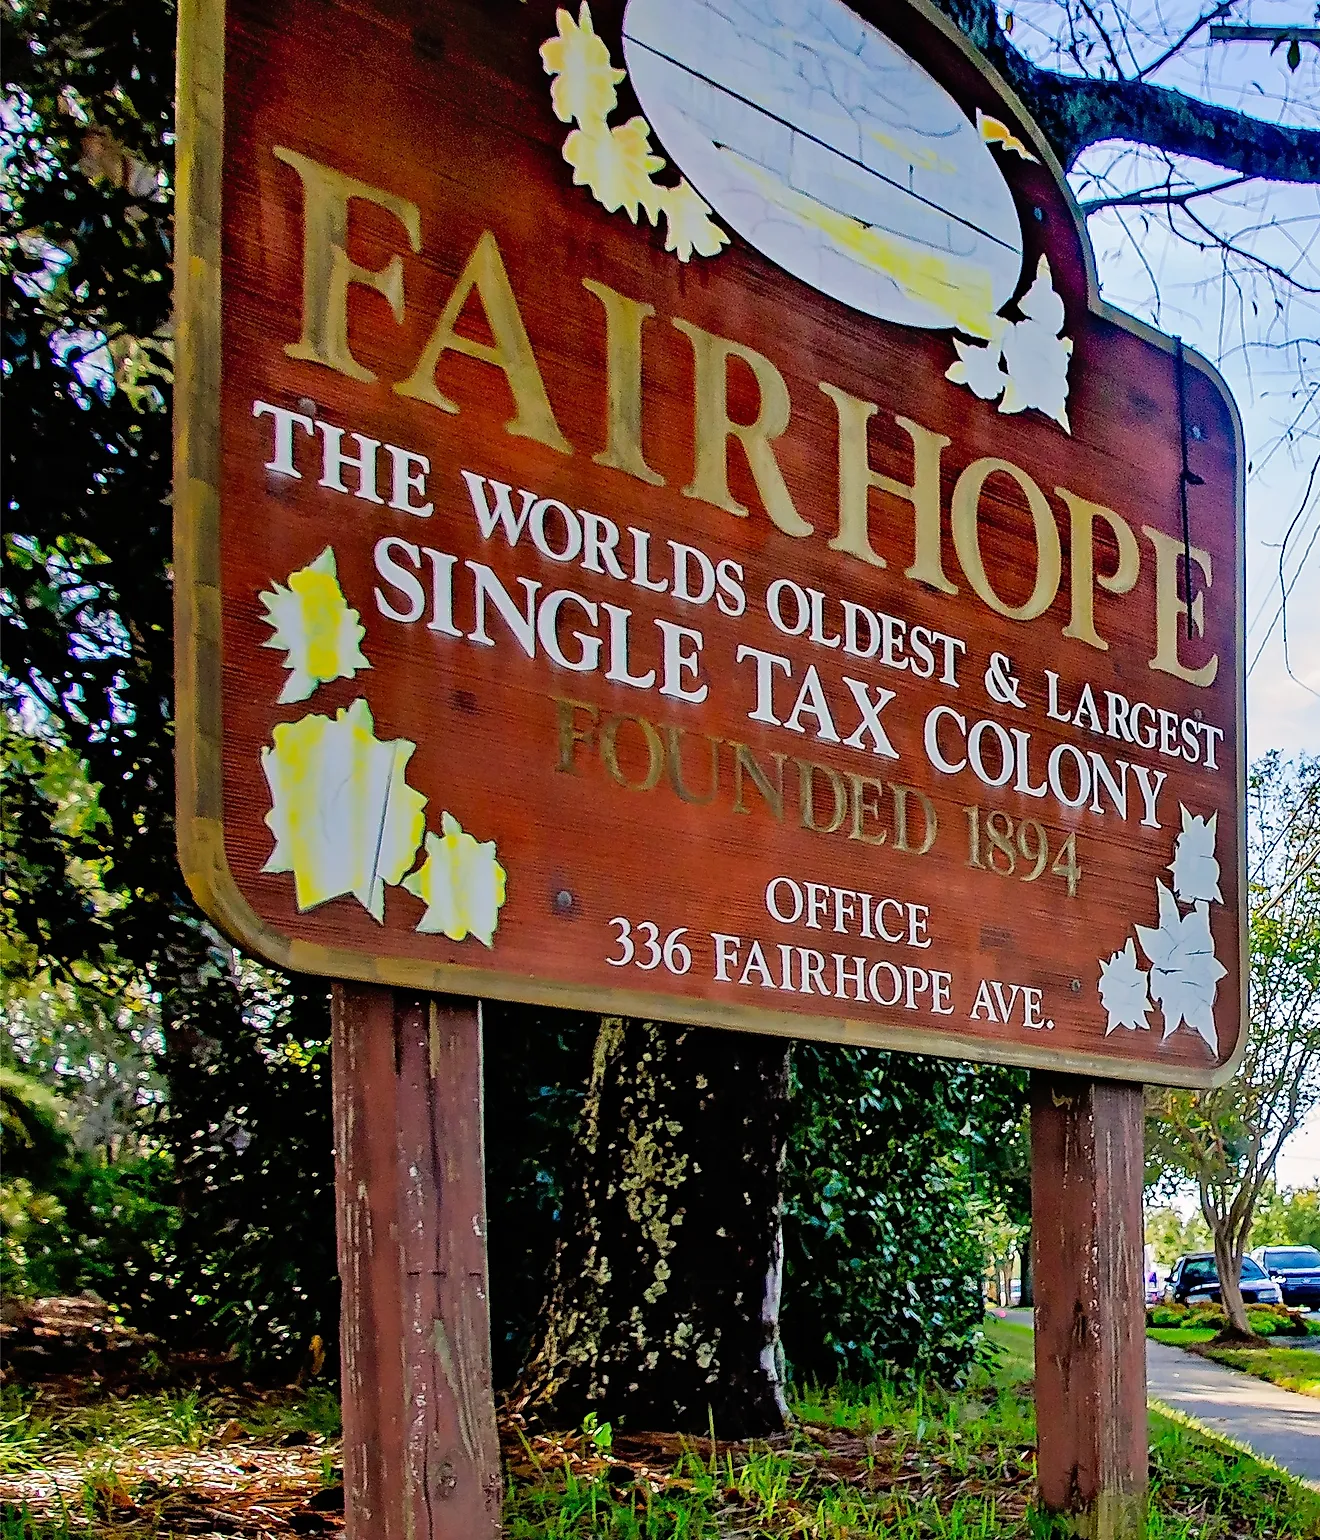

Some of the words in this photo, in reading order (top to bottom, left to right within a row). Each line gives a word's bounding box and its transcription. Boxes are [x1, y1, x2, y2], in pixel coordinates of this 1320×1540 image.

[273, 145, 1218, 687] FAIRHOPE
[252, 399, 434, 518] THE
[461, 469, 746, 617] WORLDS
[766, 578, 965, 688] OLDEST
[984, 652, 1026, 709] &
[1044, 670, 1223, 771] LARGEST
[374, 536, 709, 705] SINGLE
[737, 645, 900, 760] TAX
[923, 705, 1167, 829] COLONY
[552, 698, 938, 856] FOUNDED
[963, 804, 1082, 898] 1894
[765, 876, 932, 949] OFFICE
[606, 917, 692, 975] 336
[711, 932, 955, 1016] FAIRHOPE
[971, 978, 1055, 1031] AVE.
